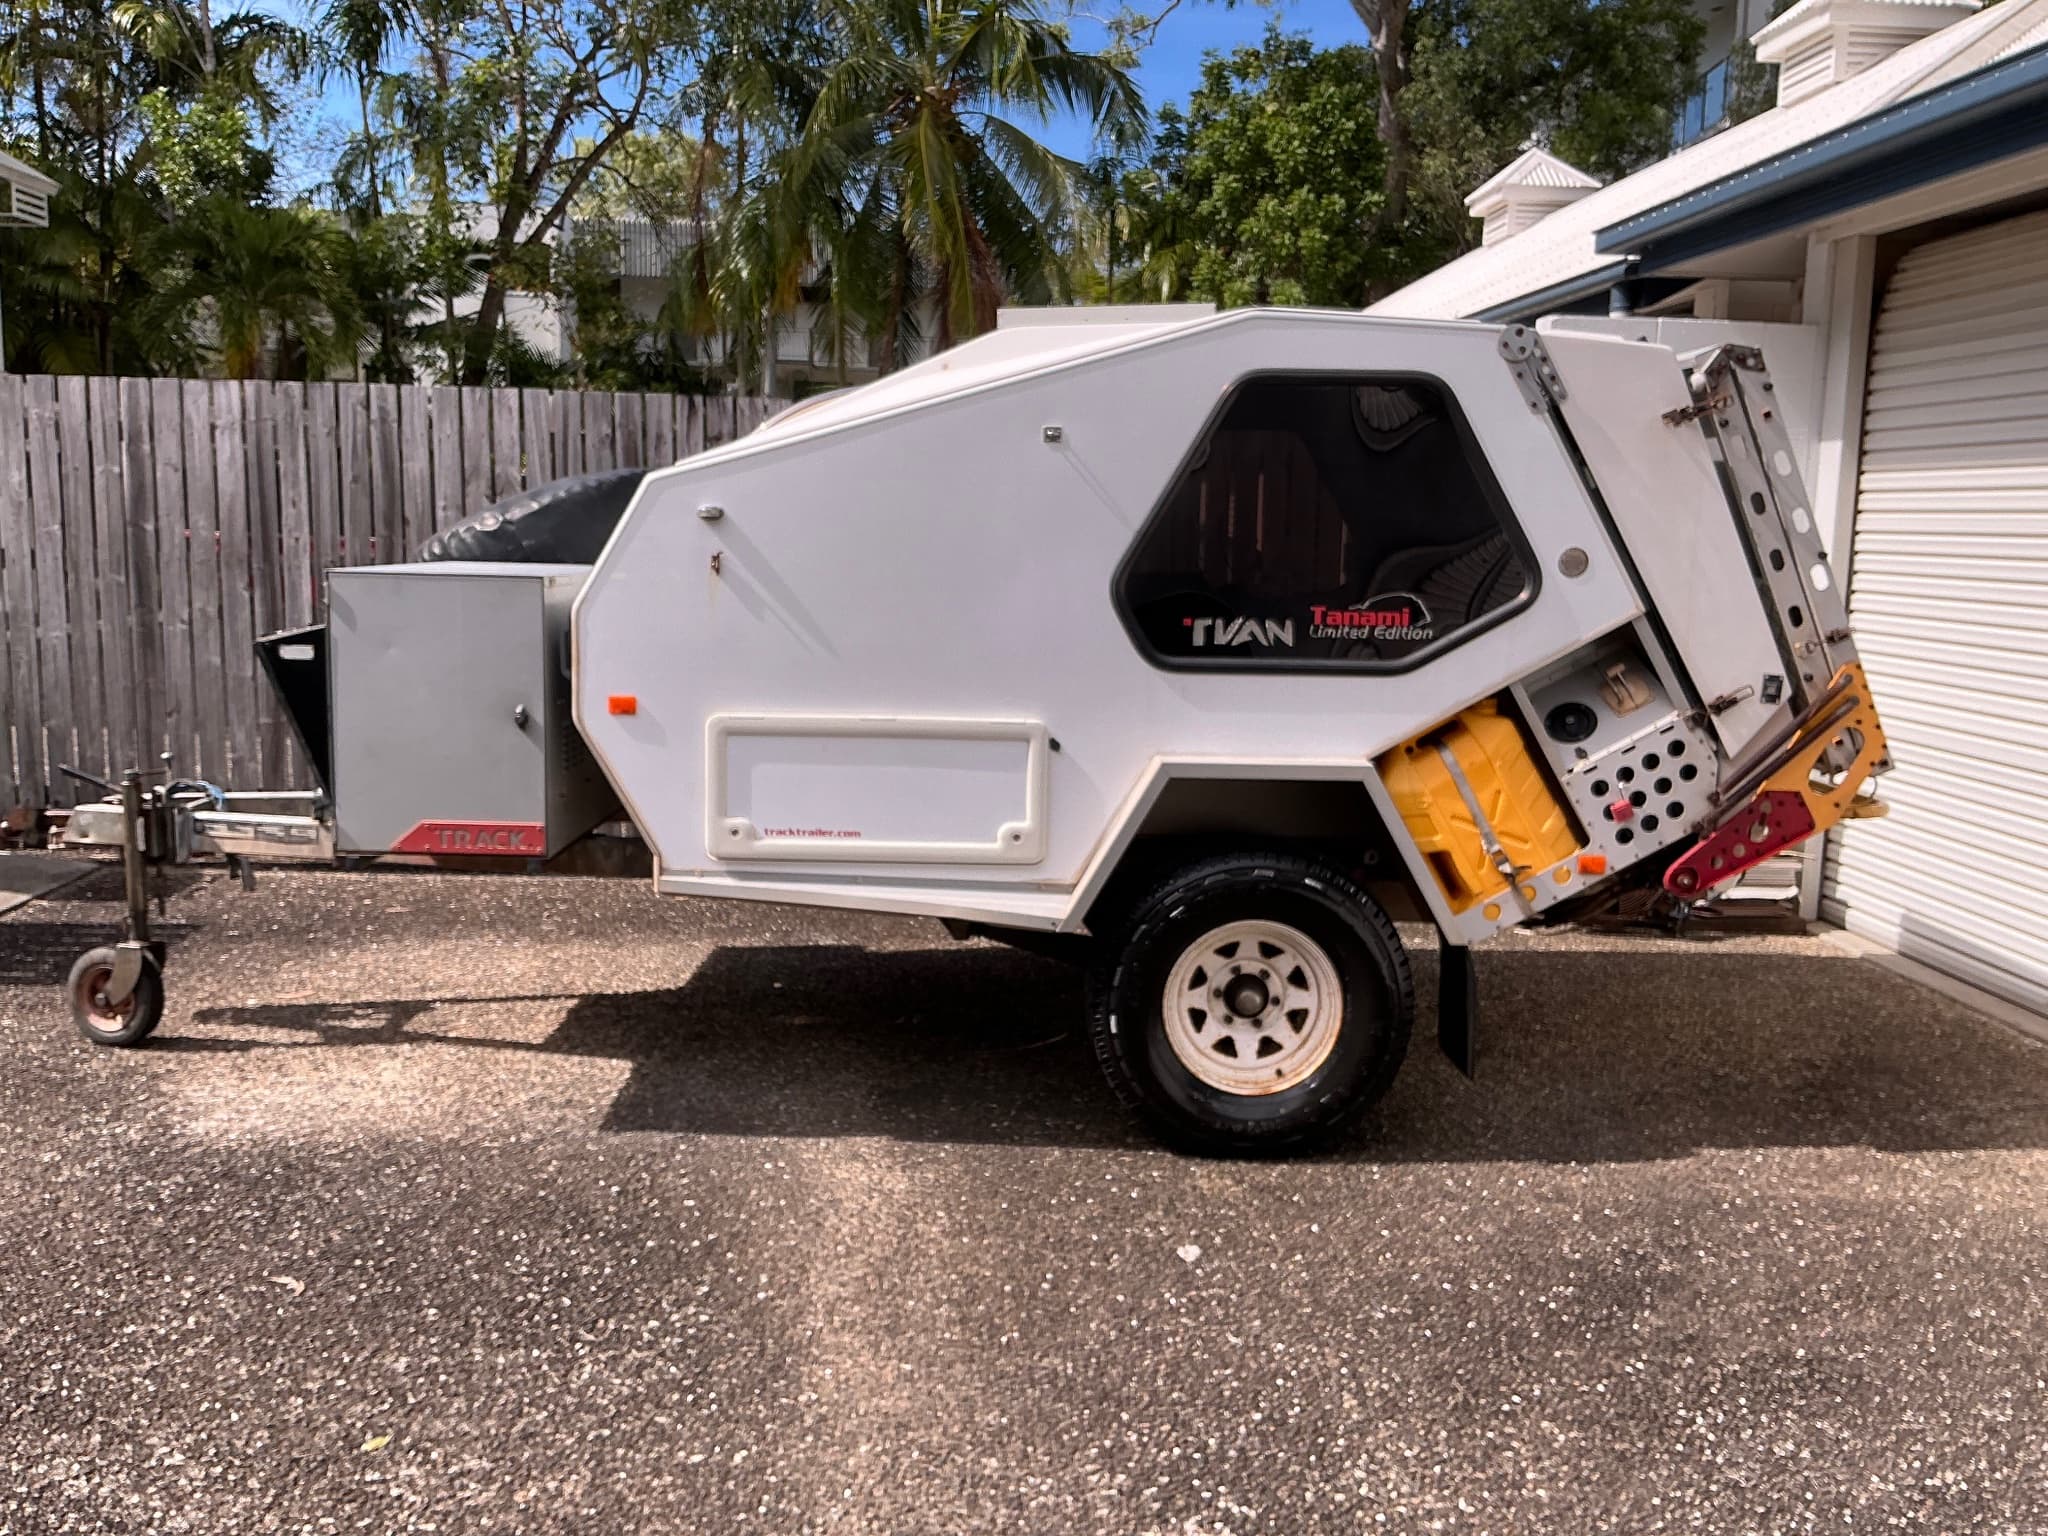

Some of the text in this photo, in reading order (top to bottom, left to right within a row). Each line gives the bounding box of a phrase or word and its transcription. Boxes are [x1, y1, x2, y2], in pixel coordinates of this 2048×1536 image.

[1310, 605, 1410, 627] Tanami
[1184, 616, 1294, 647] TVAN
[1309, 624, 1433, 641] Limited Edition
[434, 828, 526, 850] TRACK
[764, 827, 862, 839] tracktrailer.com
